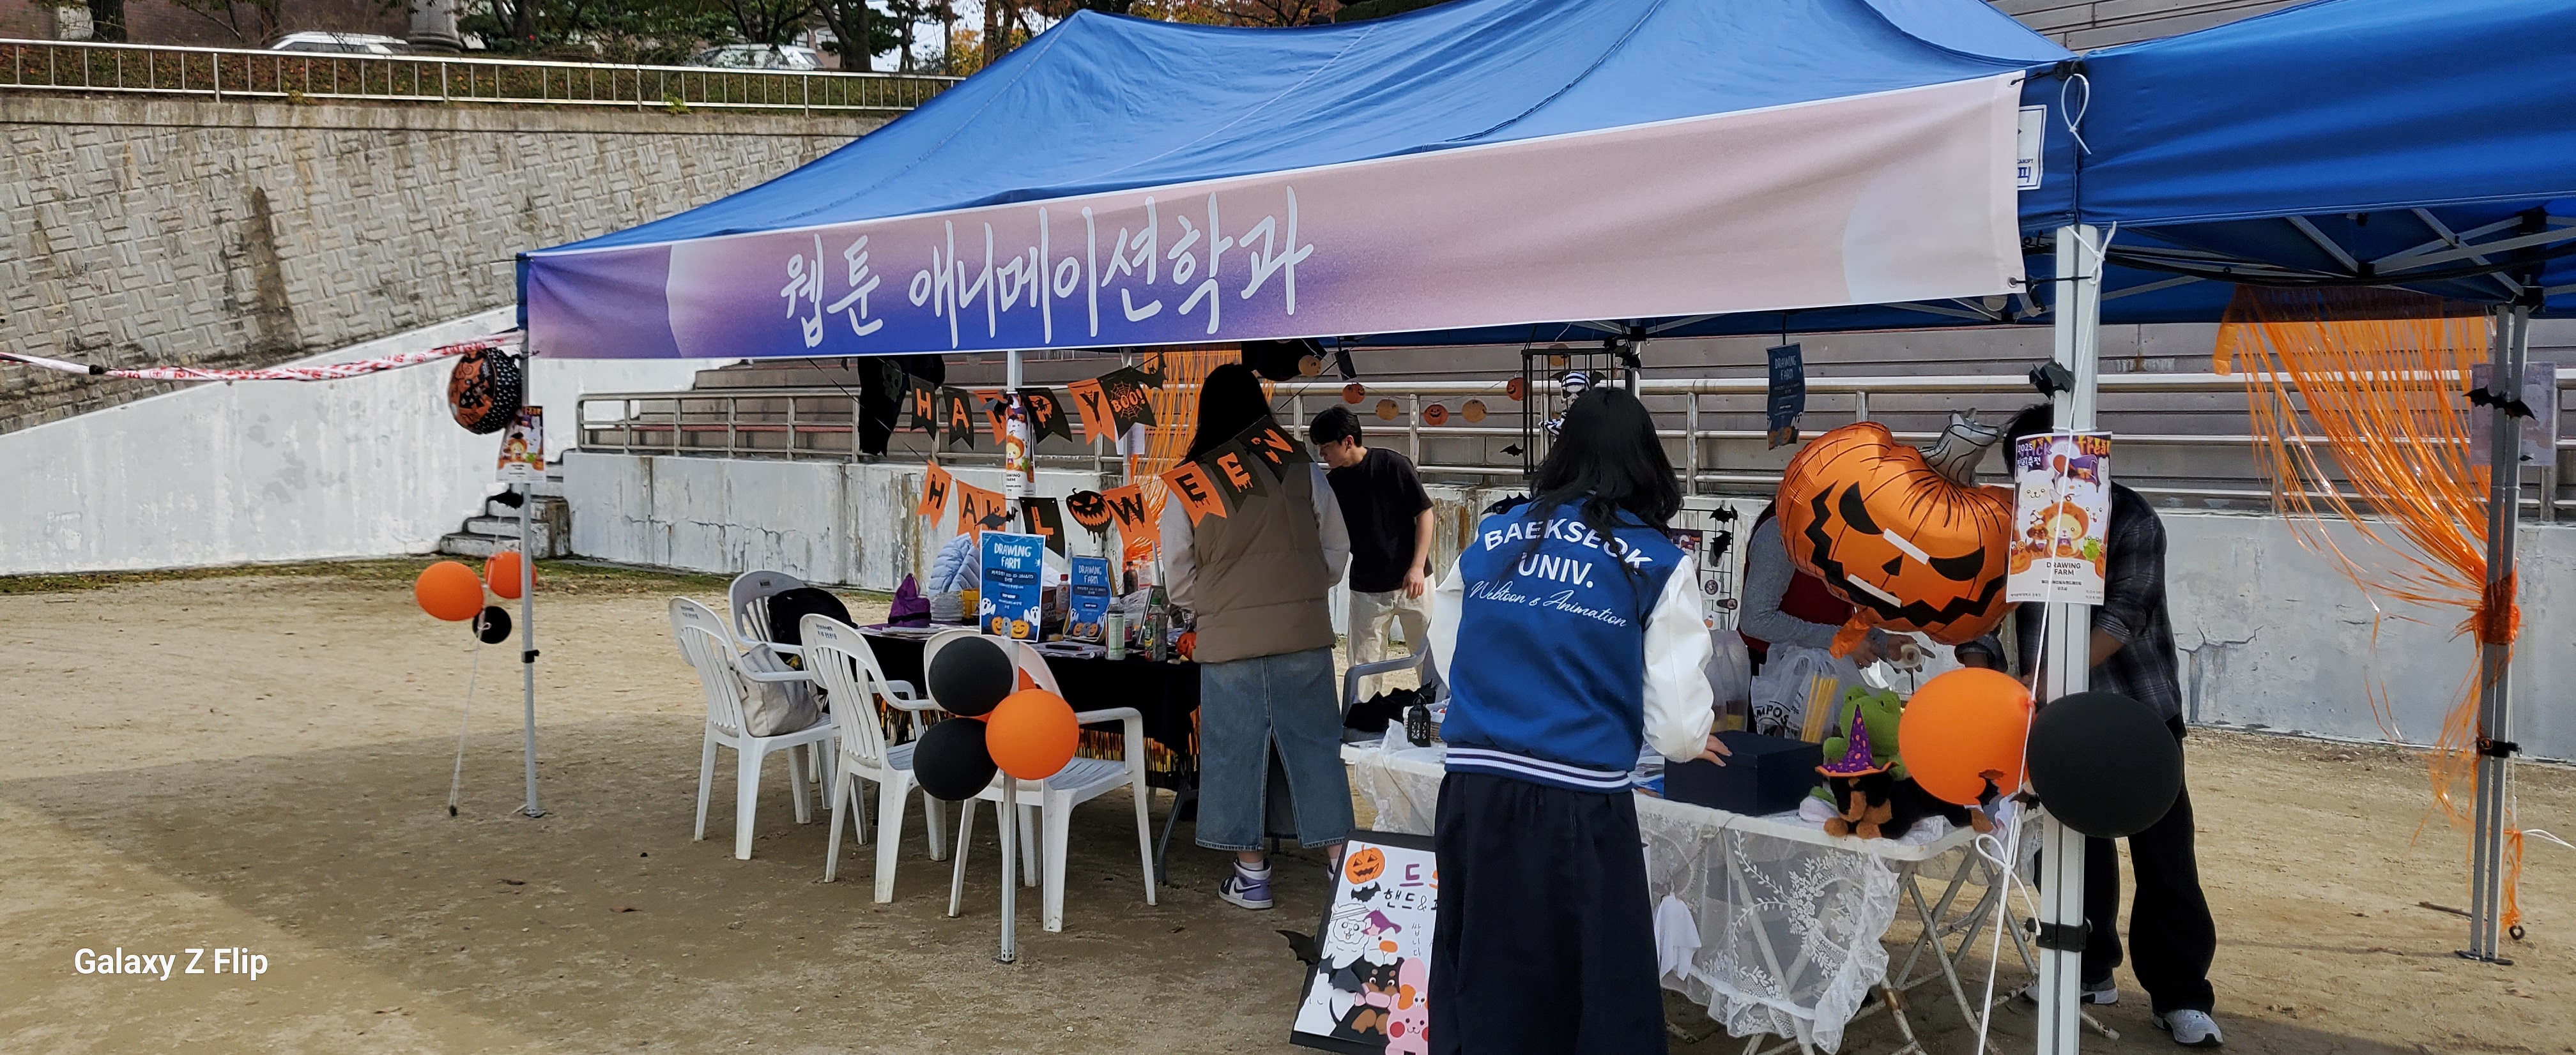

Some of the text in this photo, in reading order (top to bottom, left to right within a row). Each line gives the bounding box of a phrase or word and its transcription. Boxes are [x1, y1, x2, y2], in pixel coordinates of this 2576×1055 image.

[780, 185, 1314, 350] 웹툰 애니메이션학과
[1110, 388, 1146, 413] BOO!
[2018, 443, 2033, 453] 2025
[994, 542, 1032, 558] DRAWING
[1484, 518, 1653, 575] BAEKSEOK
[1001, 557, 1021, 569] FARM
[1078, 565, 1102, 575] DRAWING
[1518, 552, 1594, 588] UNIV.
[1084, 575, 1099, 584] FARM
[1469, 580, 1526, 604] Webtoon
[1543, 589, 1628, 628] Animation
[1754, 704, 1789, 725] MPOS
